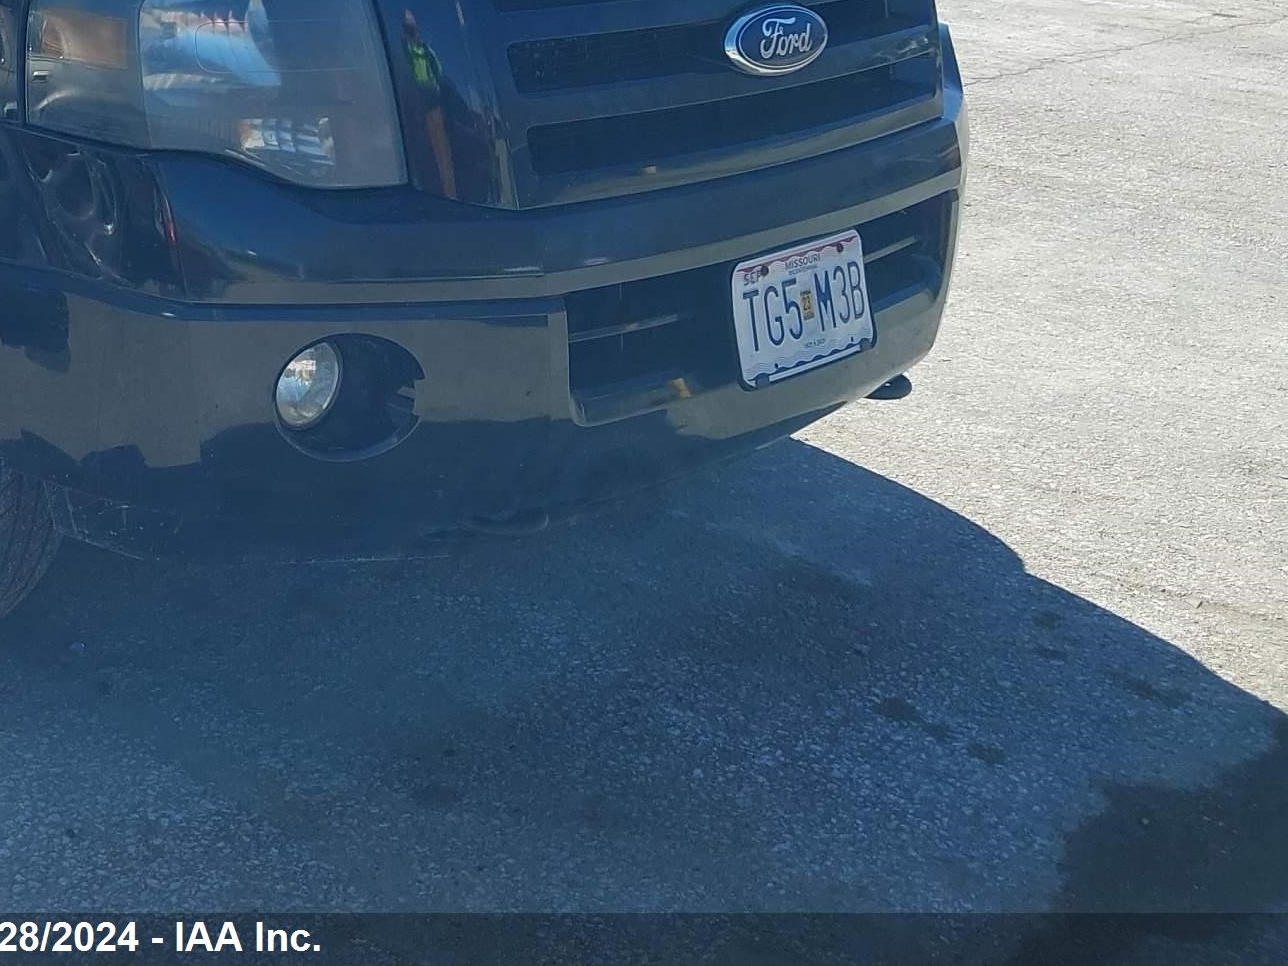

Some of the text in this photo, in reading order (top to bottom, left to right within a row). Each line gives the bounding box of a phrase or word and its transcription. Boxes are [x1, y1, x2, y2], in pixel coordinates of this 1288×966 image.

[760, 17, 812, 58] Ford
[784, 253, 821, 270] MISSOURI
[743, 261, 865, 352] TG5 M3B
